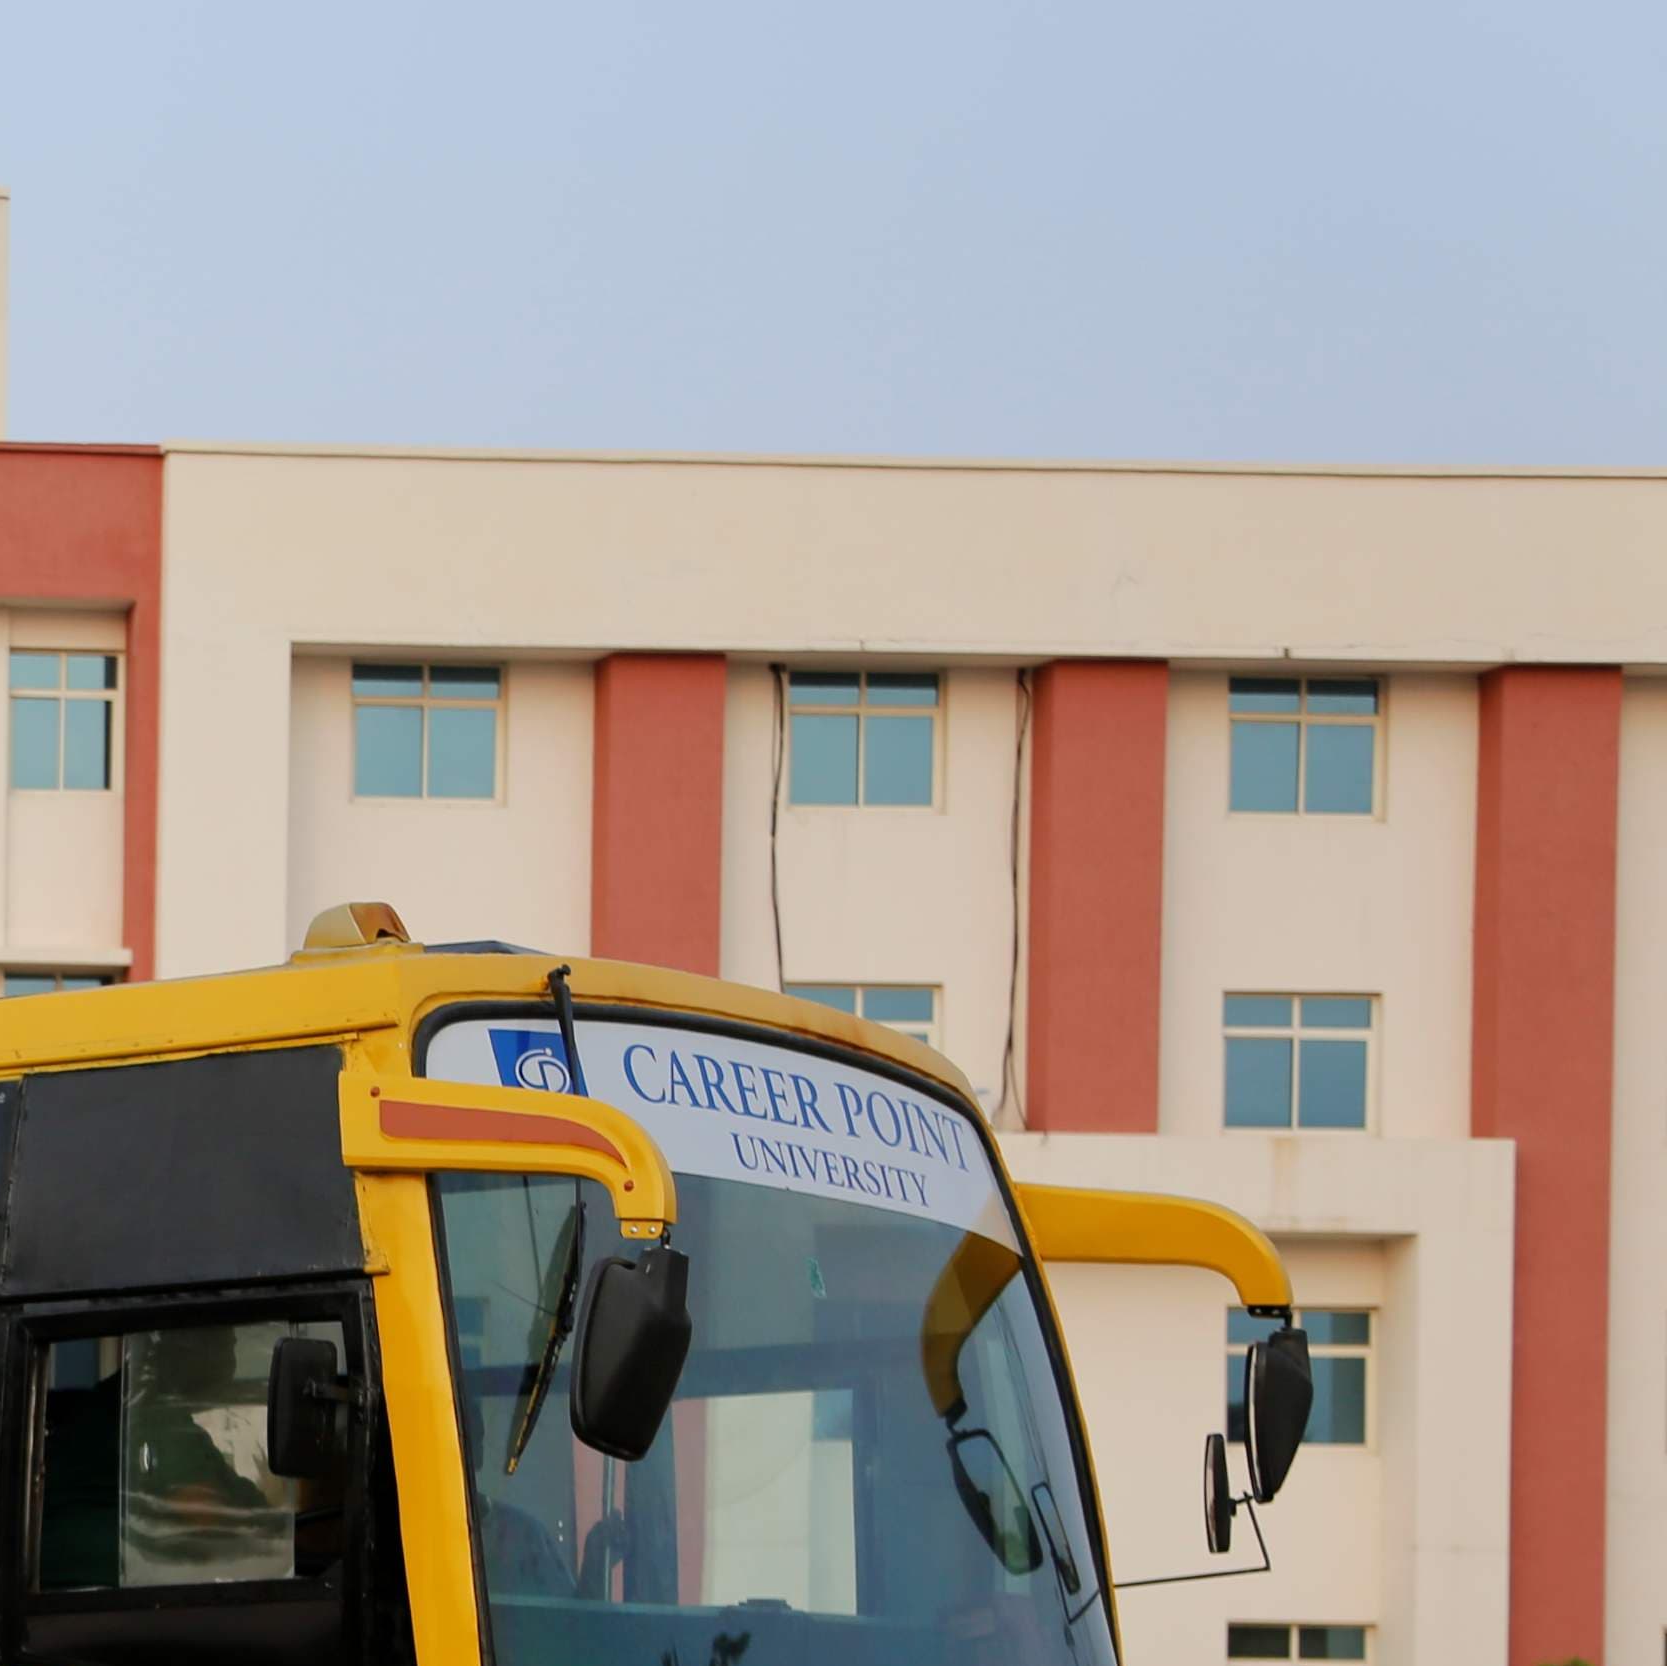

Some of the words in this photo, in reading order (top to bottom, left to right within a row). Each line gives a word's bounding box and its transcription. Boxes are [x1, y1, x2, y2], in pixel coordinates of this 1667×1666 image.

[623, 1044, 833, 1134] CAREER
[834, 1082, 969, 1172] POINT
[730, 1132, 929, 1207] UNIVERSITY
